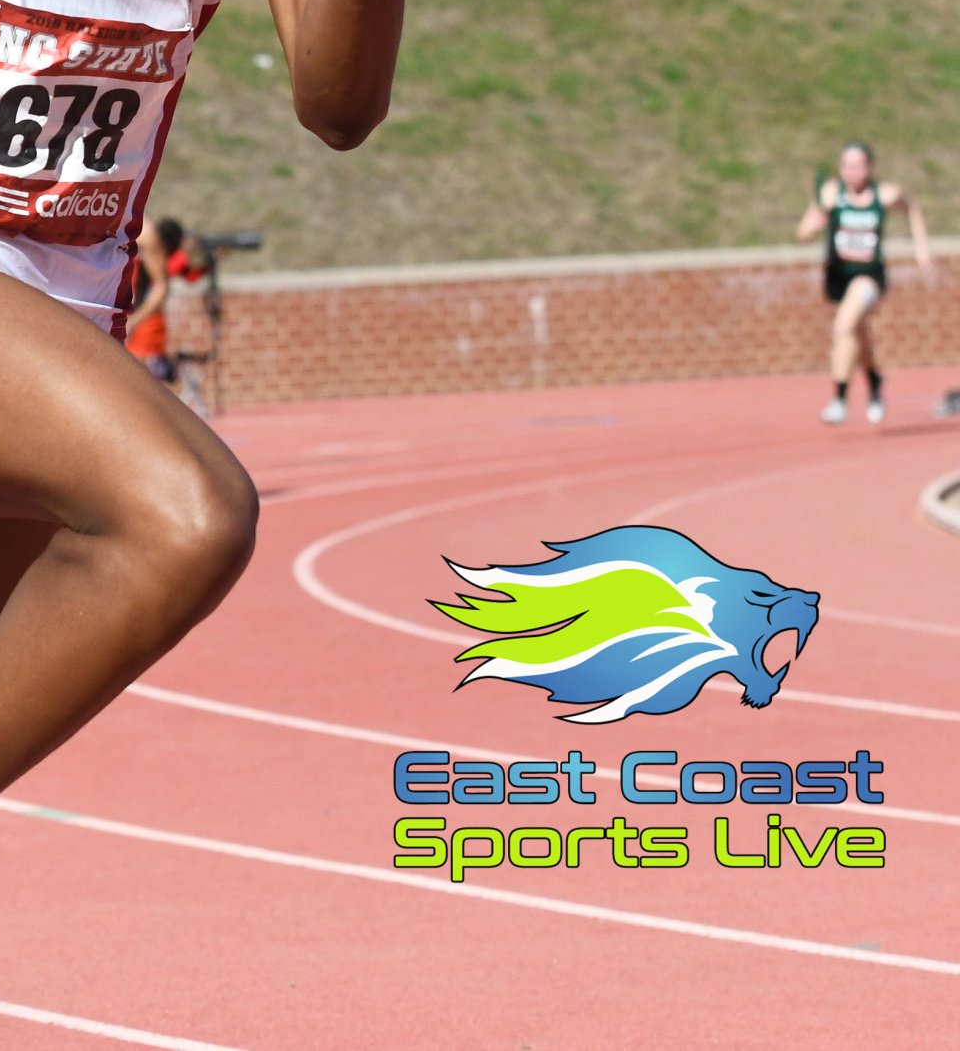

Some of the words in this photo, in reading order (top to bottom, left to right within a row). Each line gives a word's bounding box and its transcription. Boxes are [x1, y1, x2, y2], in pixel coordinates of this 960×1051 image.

[25, 13, 61, 30] 2018
[60, 39, 170, 77] STATE
[35, 188, 120, 219] adidas
